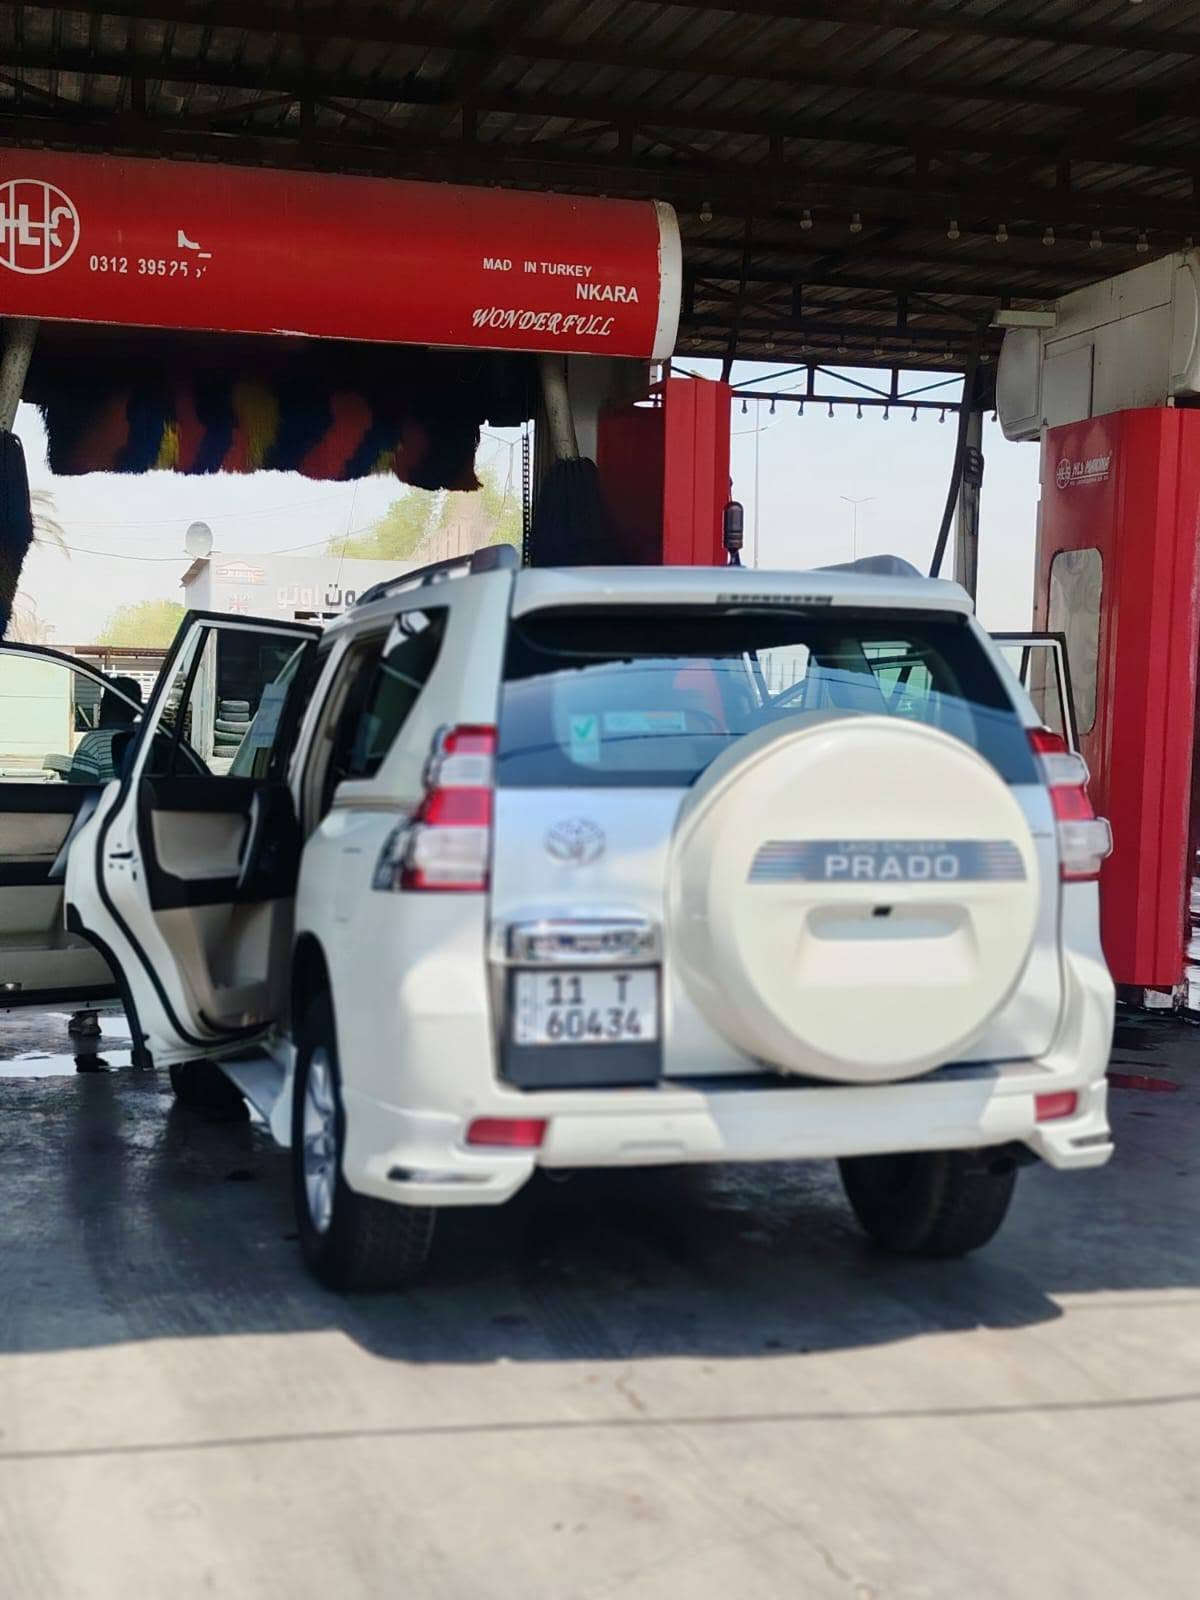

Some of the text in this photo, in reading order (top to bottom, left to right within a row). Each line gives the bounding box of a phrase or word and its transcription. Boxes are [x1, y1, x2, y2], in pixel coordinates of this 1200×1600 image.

[89, 255, 128, 274] 0312
[482, 257, 592, 277] MAD IN TURKEY
[575, 283, 639, 303] NKARA
[471, 306, 615, 336] WONDERFULL
[824, 855, 959, 880] PRADO
[547, 974, 633, 1005] 11 T
[545, 1008, 642, 1039] 60434
